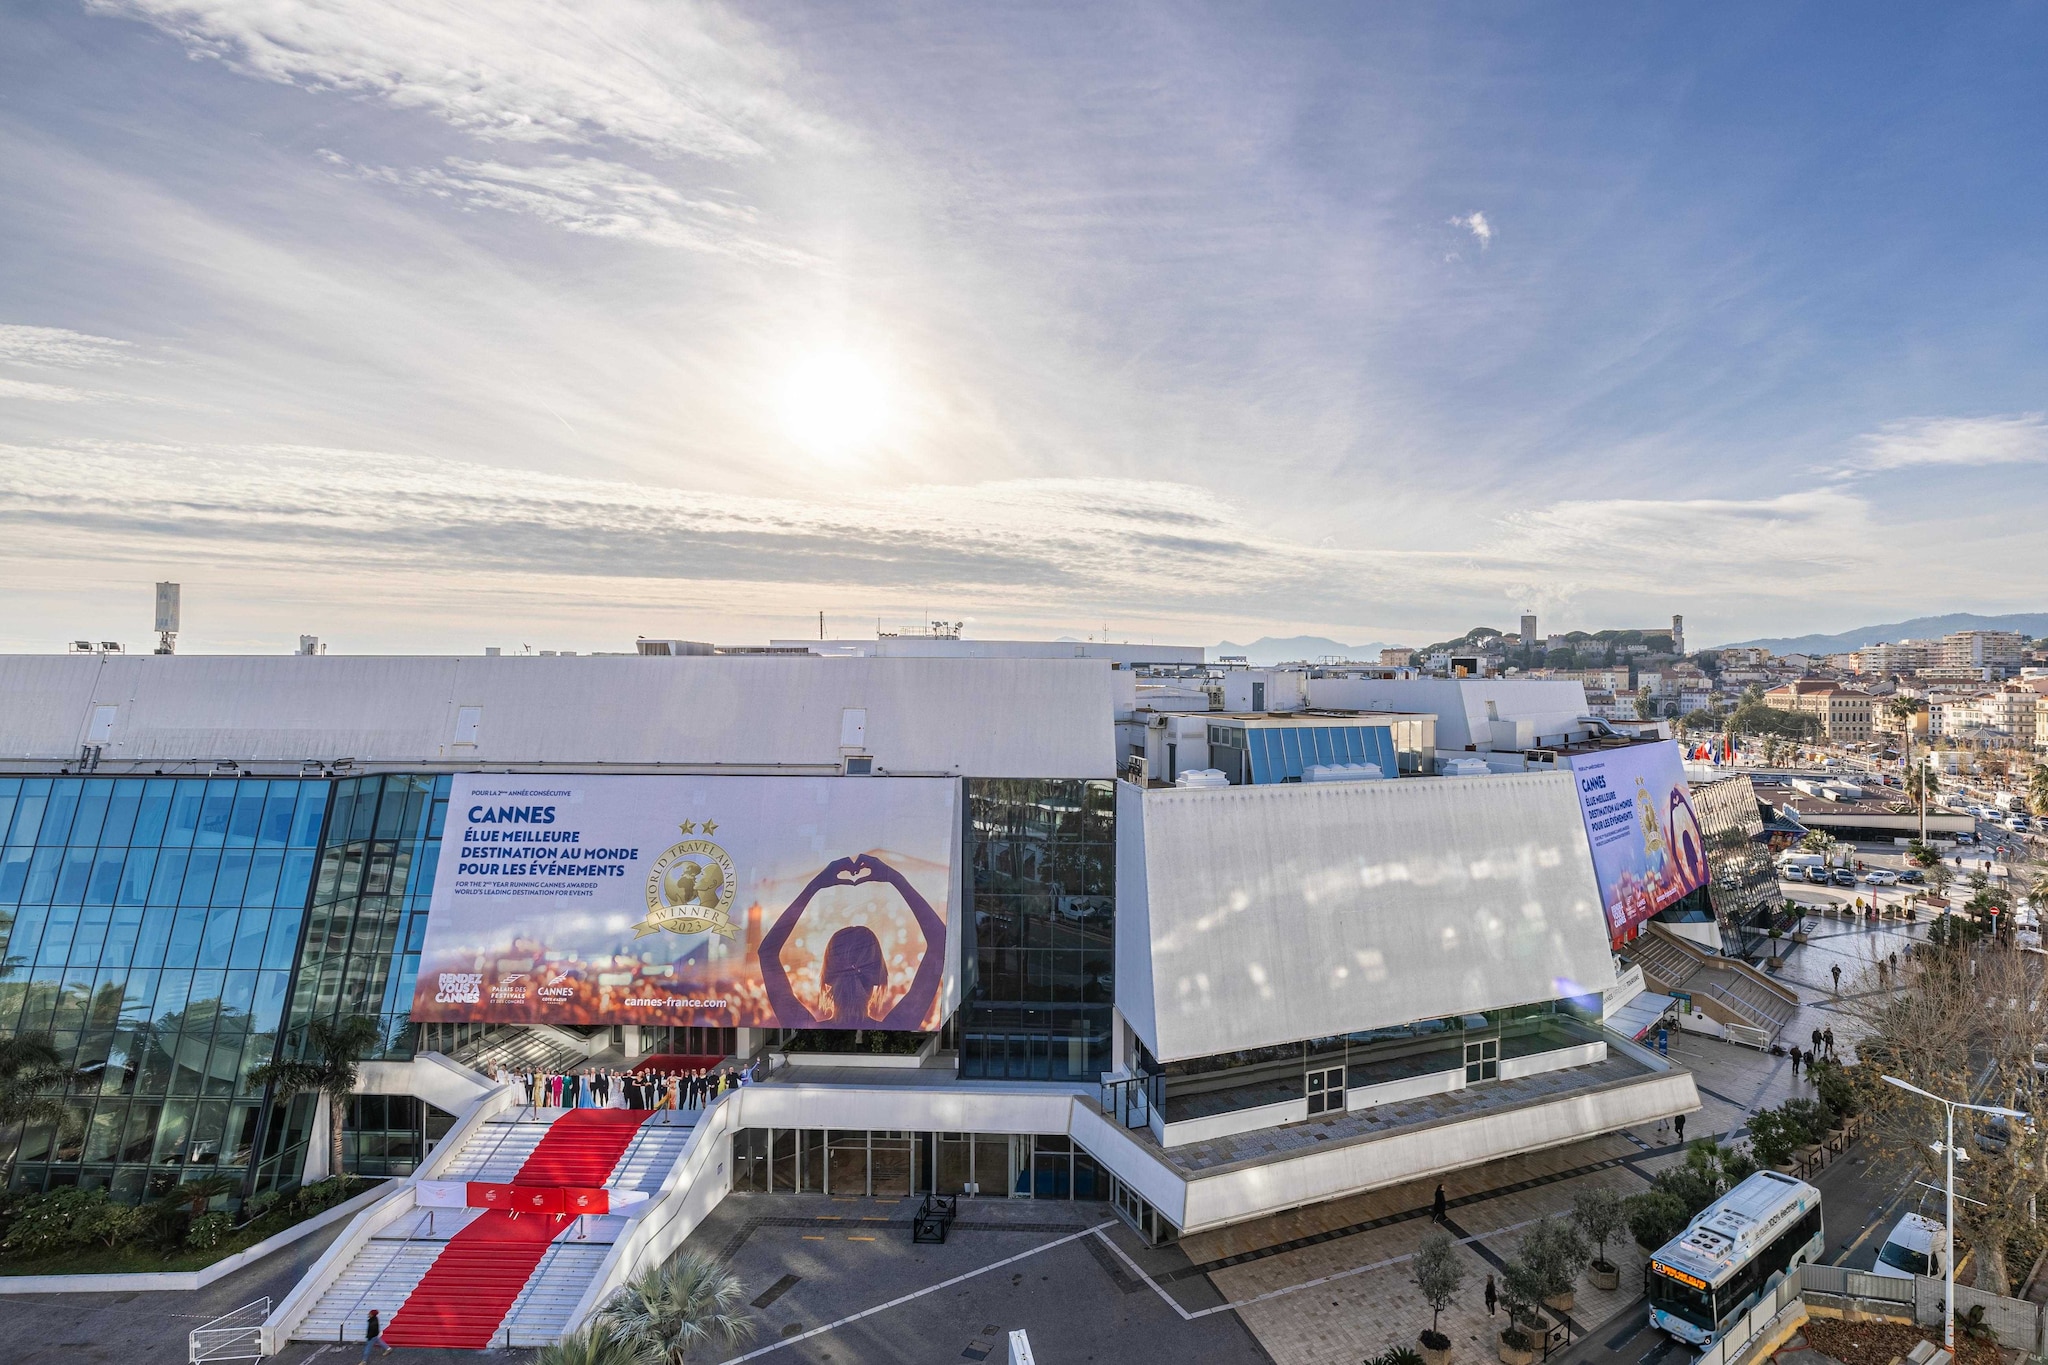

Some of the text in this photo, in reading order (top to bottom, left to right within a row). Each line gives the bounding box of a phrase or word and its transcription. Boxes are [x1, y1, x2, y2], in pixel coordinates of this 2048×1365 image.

[1582, 775, 1606, 792] CANNES
[468, 805, 556, 824] CANNES
[1592, 820, 1604, 832] POUR
[464, 827, 580, 843] ÉLUE MEILLEURE
[461, 847, 638, 860] DESTINATION AU MONDE
[458, 860, 625, 876] POUR LES ÉVÉNEMENTS
[648, 842, 734, 908] WORLD TRAVEL AWARDS
[656, 907, 719, 922] WINNER
[670, 921, 702, 932] 2023
[439, 973, 483, 984] RENDEZ
[439, 983, 470, 993] VOUS
[538, 987, 573, 997] CANNES
[435, 992, 480, 1003] CANNES
[624, 997, 726, 1008] cannes-france.com
